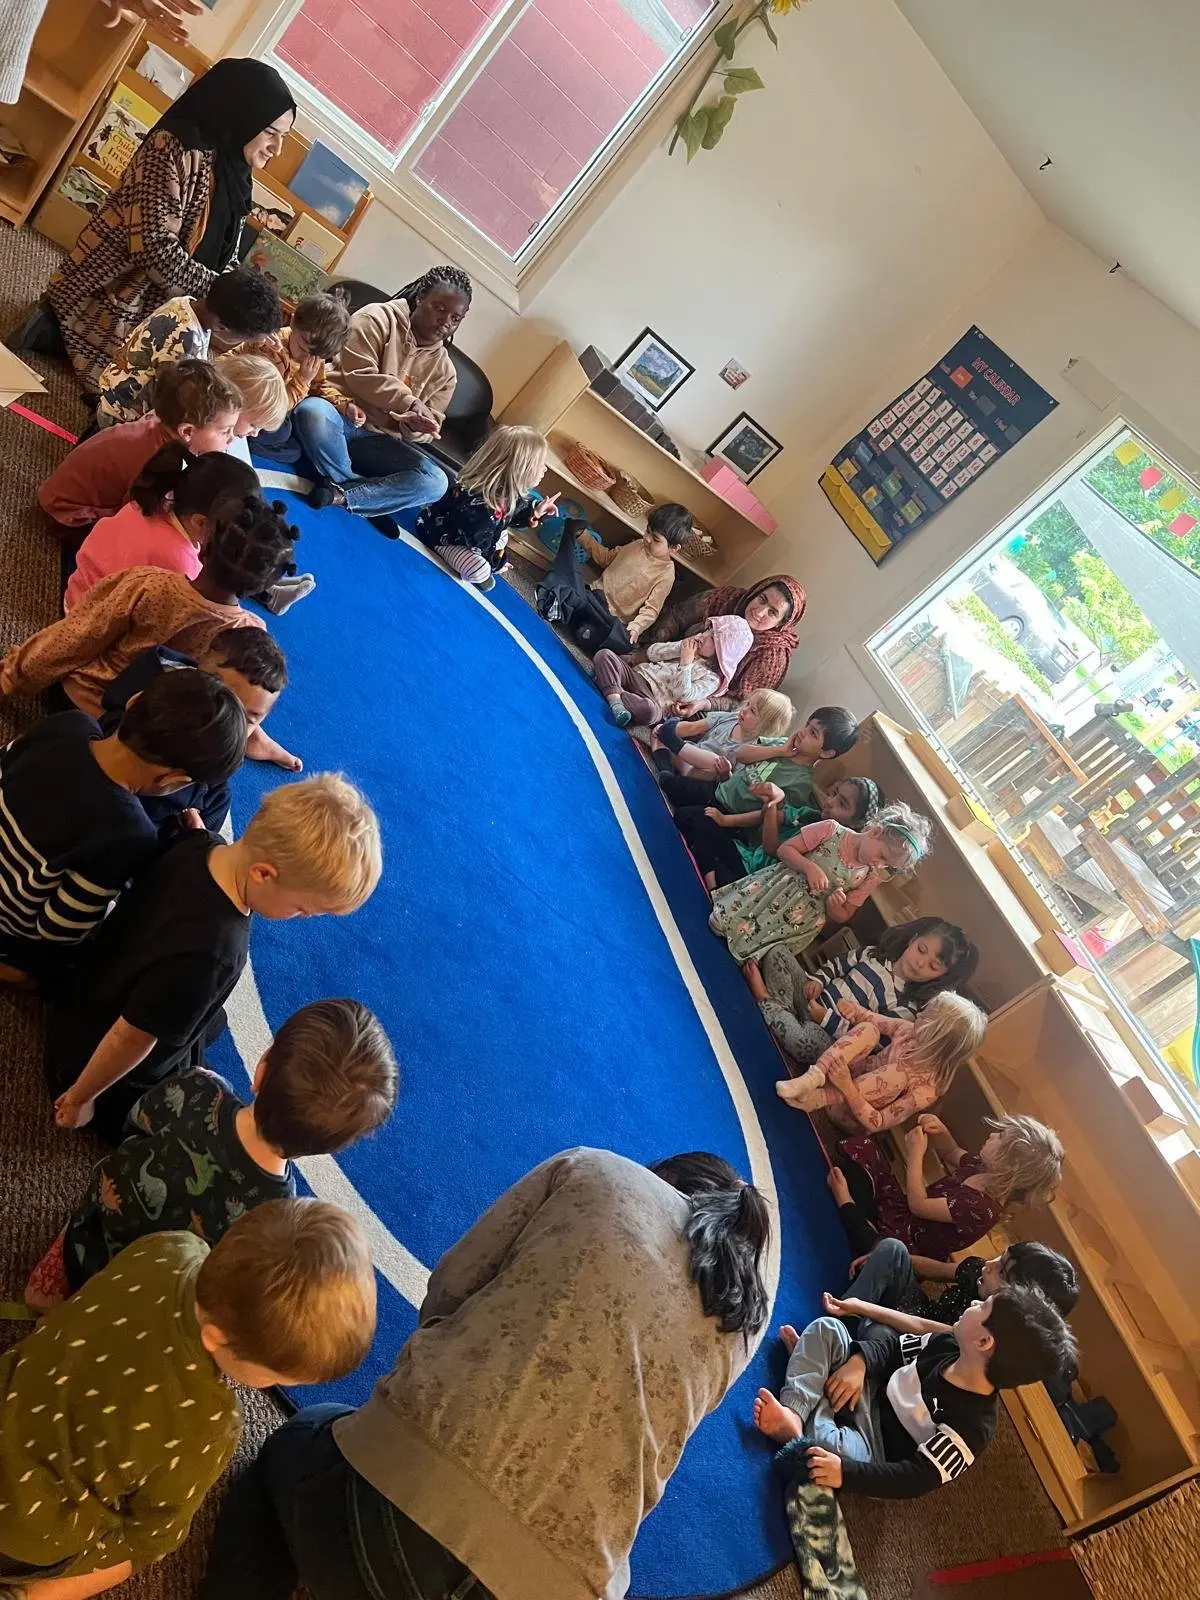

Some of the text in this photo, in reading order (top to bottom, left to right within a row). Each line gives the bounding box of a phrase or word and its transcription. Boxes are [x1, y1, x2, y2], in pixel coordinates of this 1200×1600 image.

[112, 134, 136, 152] Child
[115, 145, 133, 159] Guid
[108, 147, 131, 167] Inse
[971, 357, 985, 372] MY
[983, 367, 1021, 406] CALENDAR
[870, 423, 880, 433] 29
[926, 414, 935, 423] 10
[937, 425, 946, 435] 11
[883, 414, 892, 424] 22
[913, 448, 923, 458] 25
[922, 460, 932, 471] 26
[933, 472, 943, 482] 27
[896, 404, 968, 483] 15 16 17 18 19 20 21
